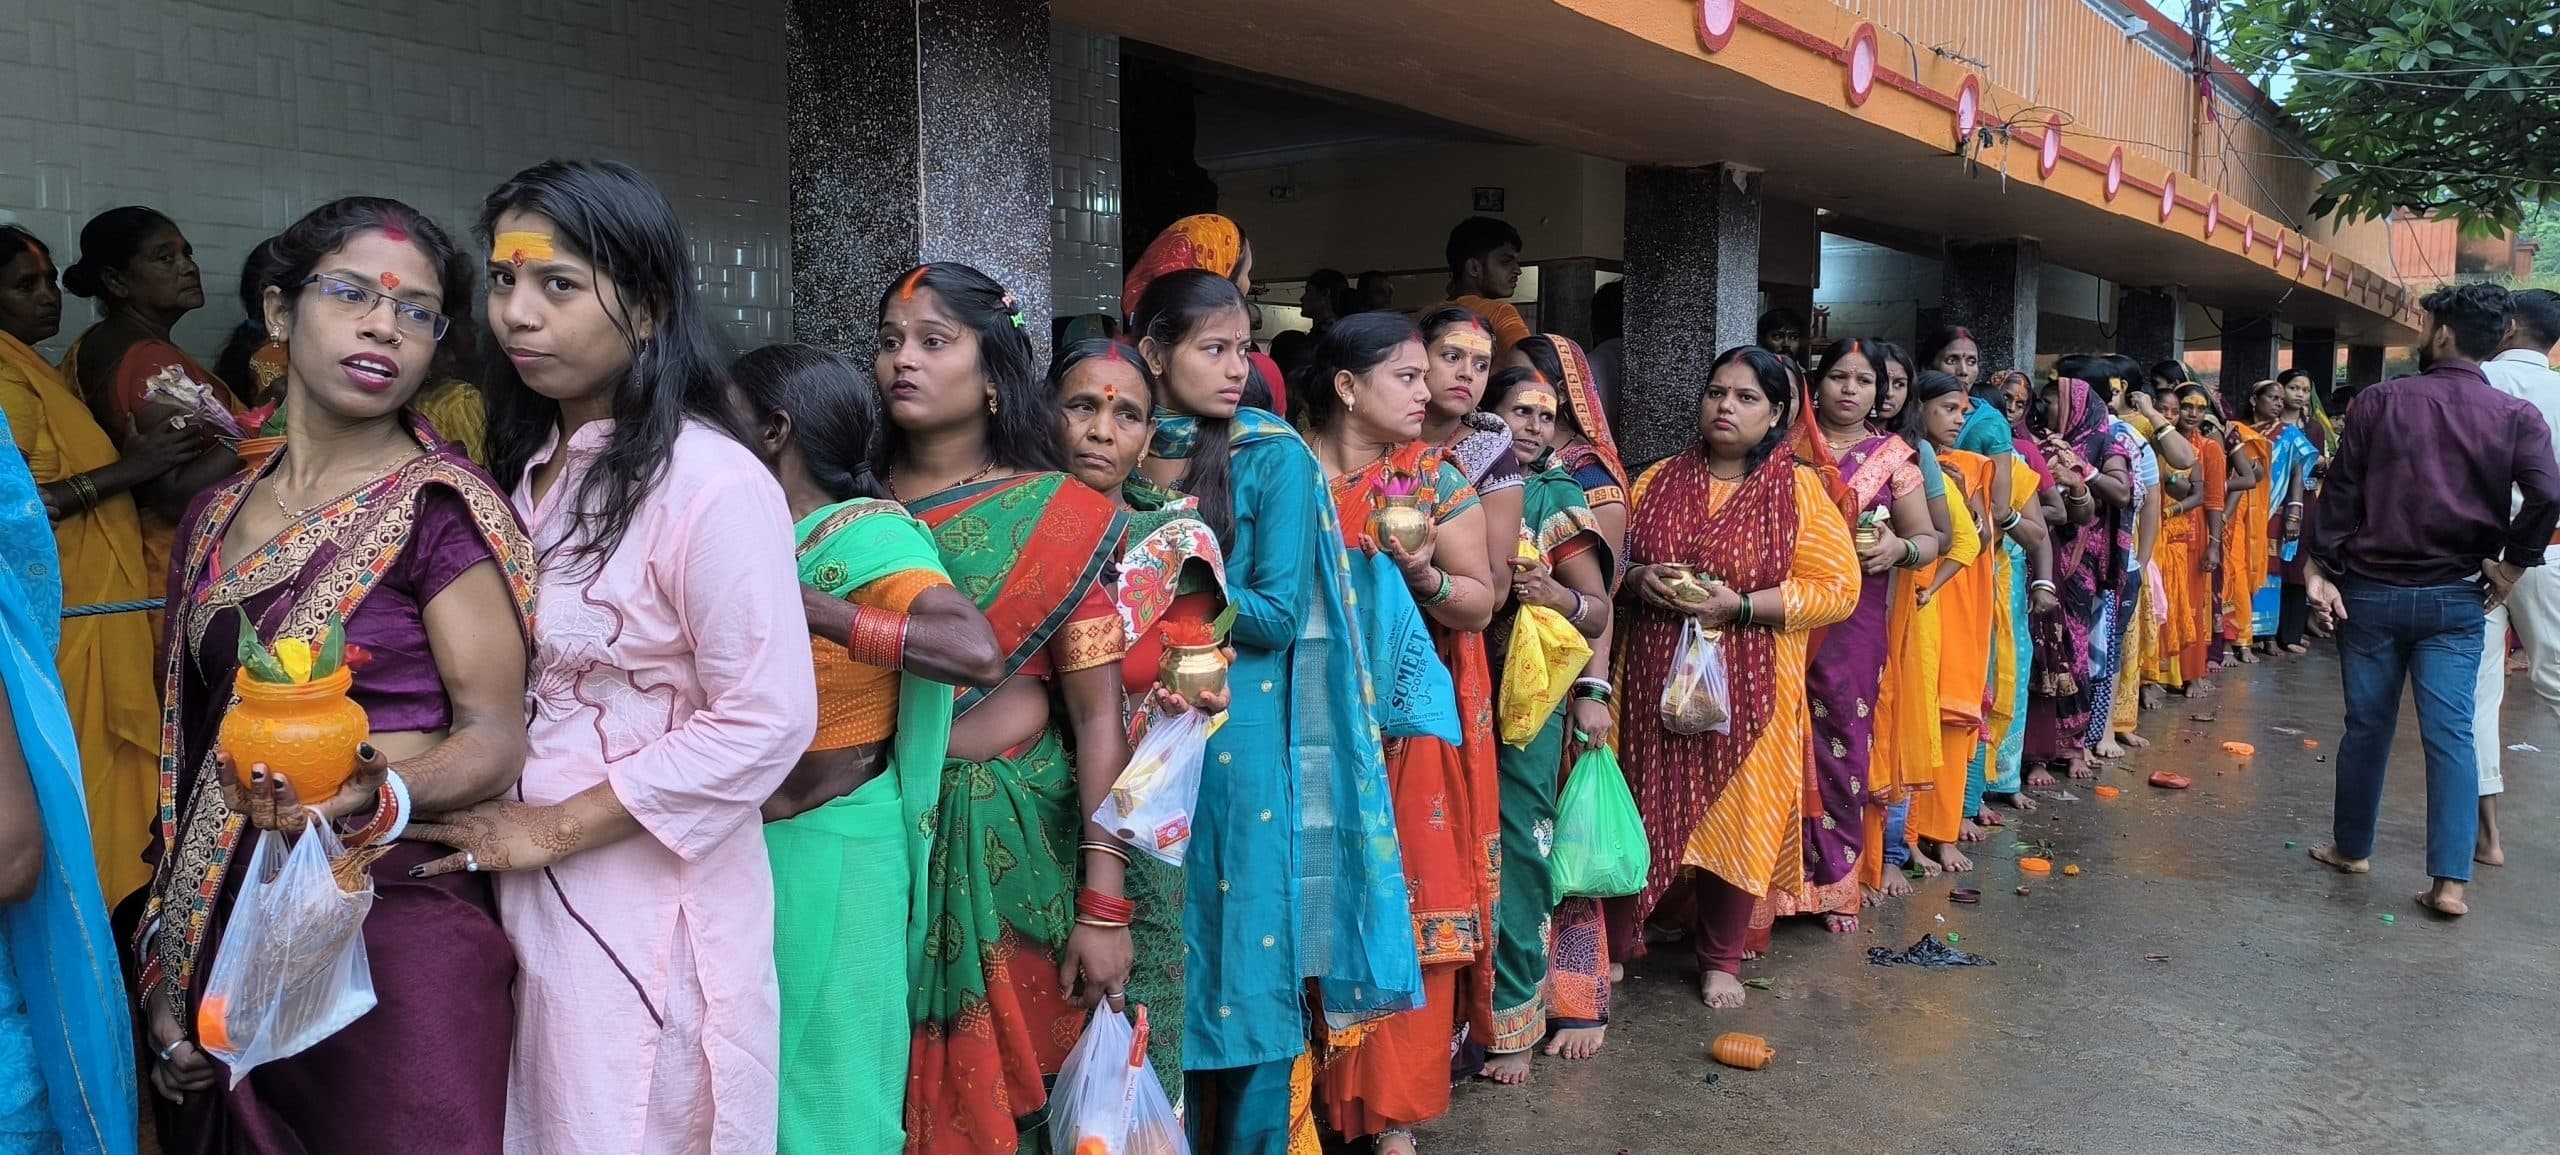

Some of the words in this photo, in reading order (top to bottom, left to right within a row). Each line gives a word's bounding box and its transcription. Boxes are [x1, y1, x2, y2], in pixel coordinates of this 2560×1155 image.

[1391, 630, 1428, 711] SUMEET
[1404, 694, 1415, 714] NET
[1412, 659, 1428, 693] COVER
